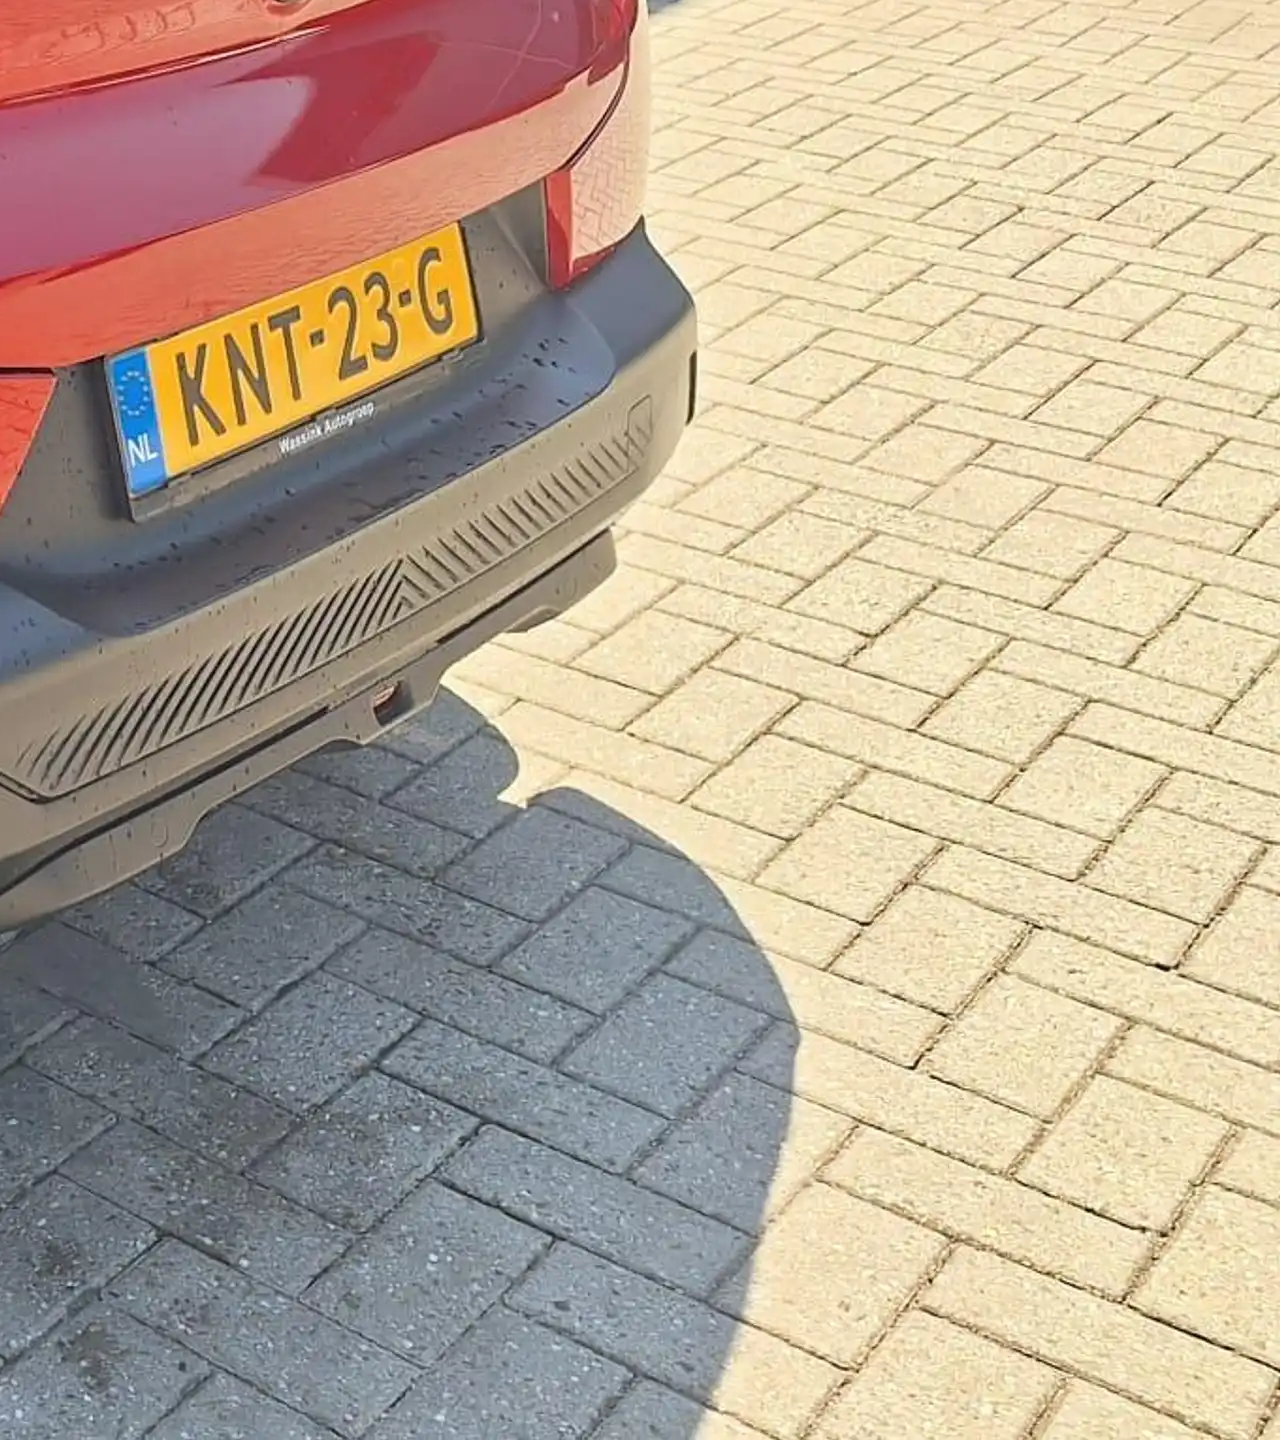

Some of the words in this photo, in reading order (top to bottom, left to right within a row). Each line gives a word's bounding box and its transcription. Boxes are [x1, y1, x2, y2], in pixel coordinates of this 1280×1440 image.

[174, 246, 454, 447] KNT-23-G
[128, 432, 159, 469] NL
[279, 423, 322, 454] Wassink
[324, 402, 375, 435] Autogroep
